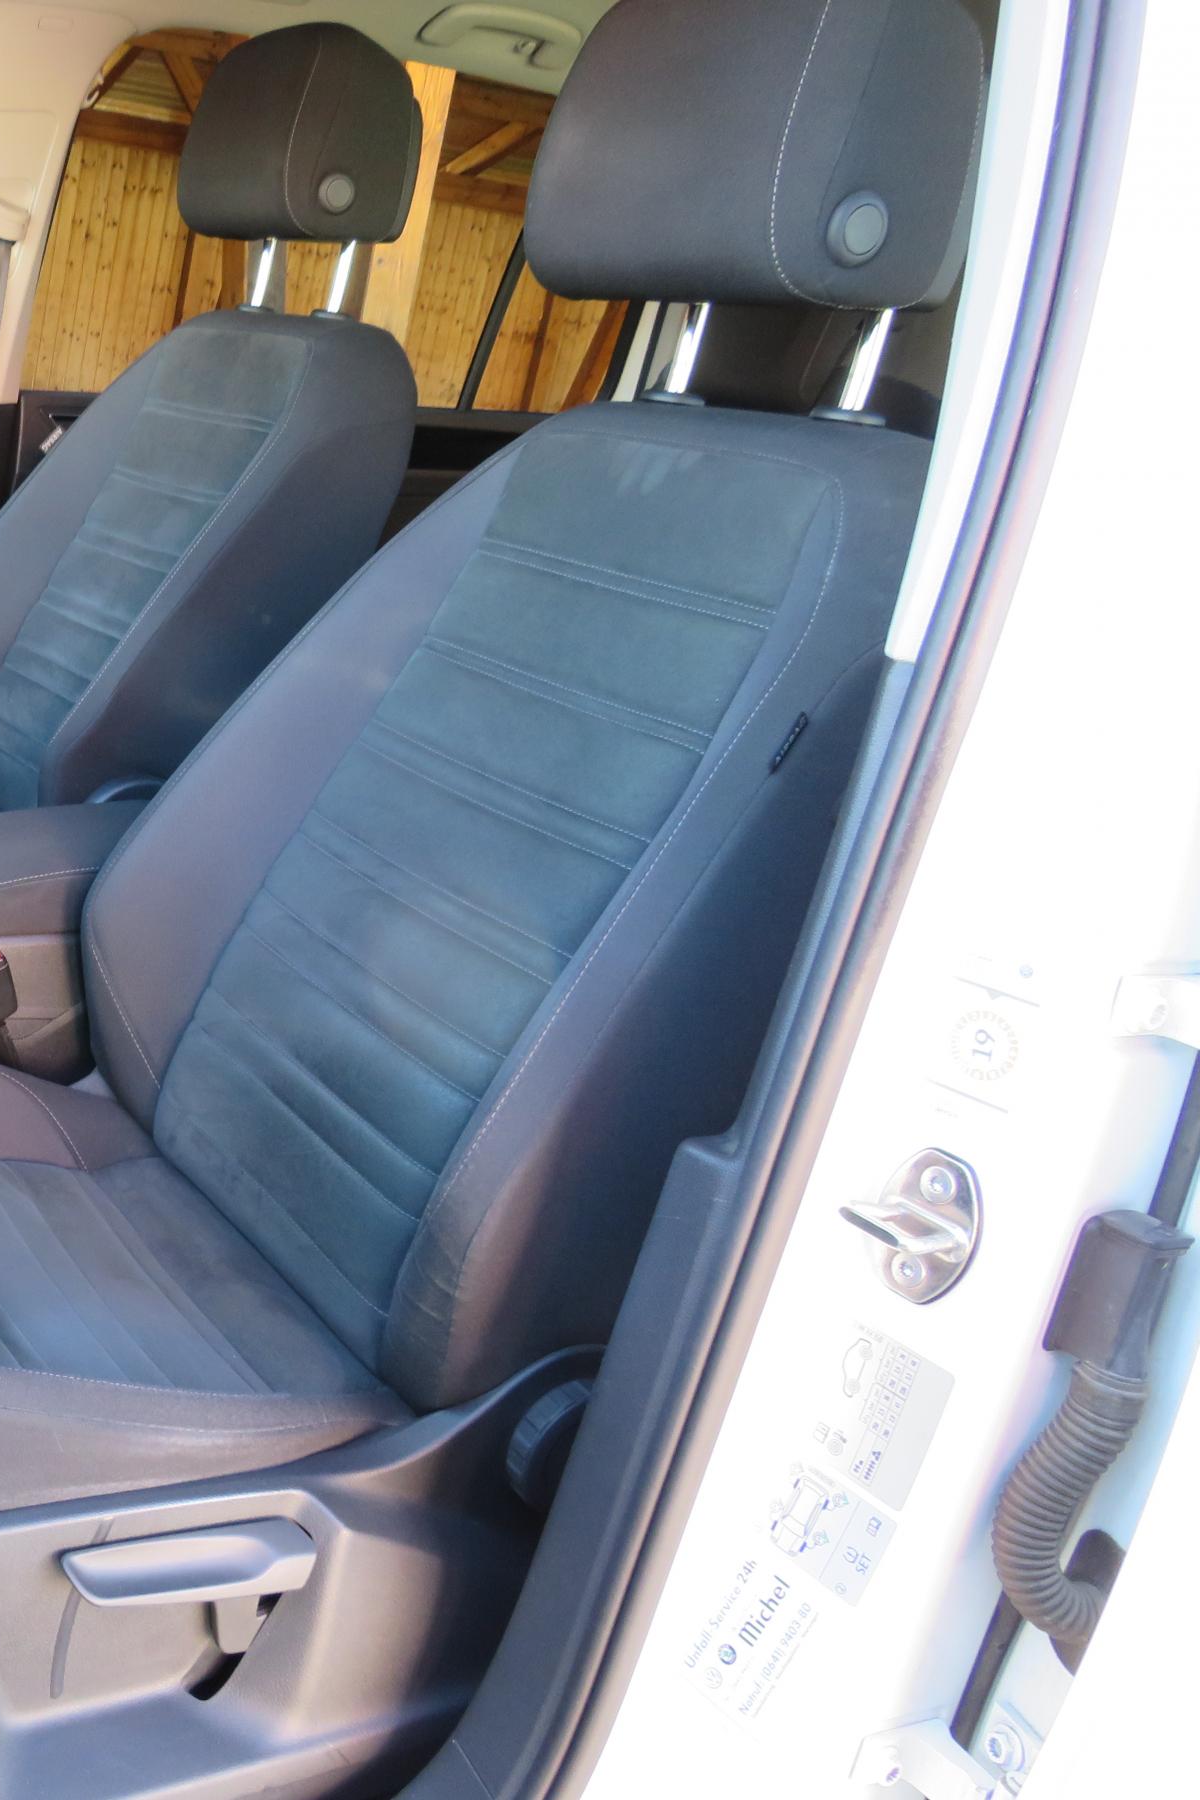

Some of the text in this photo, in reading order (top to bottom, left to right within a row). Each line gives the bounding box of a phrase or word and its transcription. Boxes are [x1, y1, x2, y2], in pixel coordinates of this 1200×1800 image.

[971, 1028, 996, 1062] 19
[735, 1558, 758, 1584] 24h
[855, 1552, 872, 1576] SET
[737, 1574, 791, 1648] Michel
